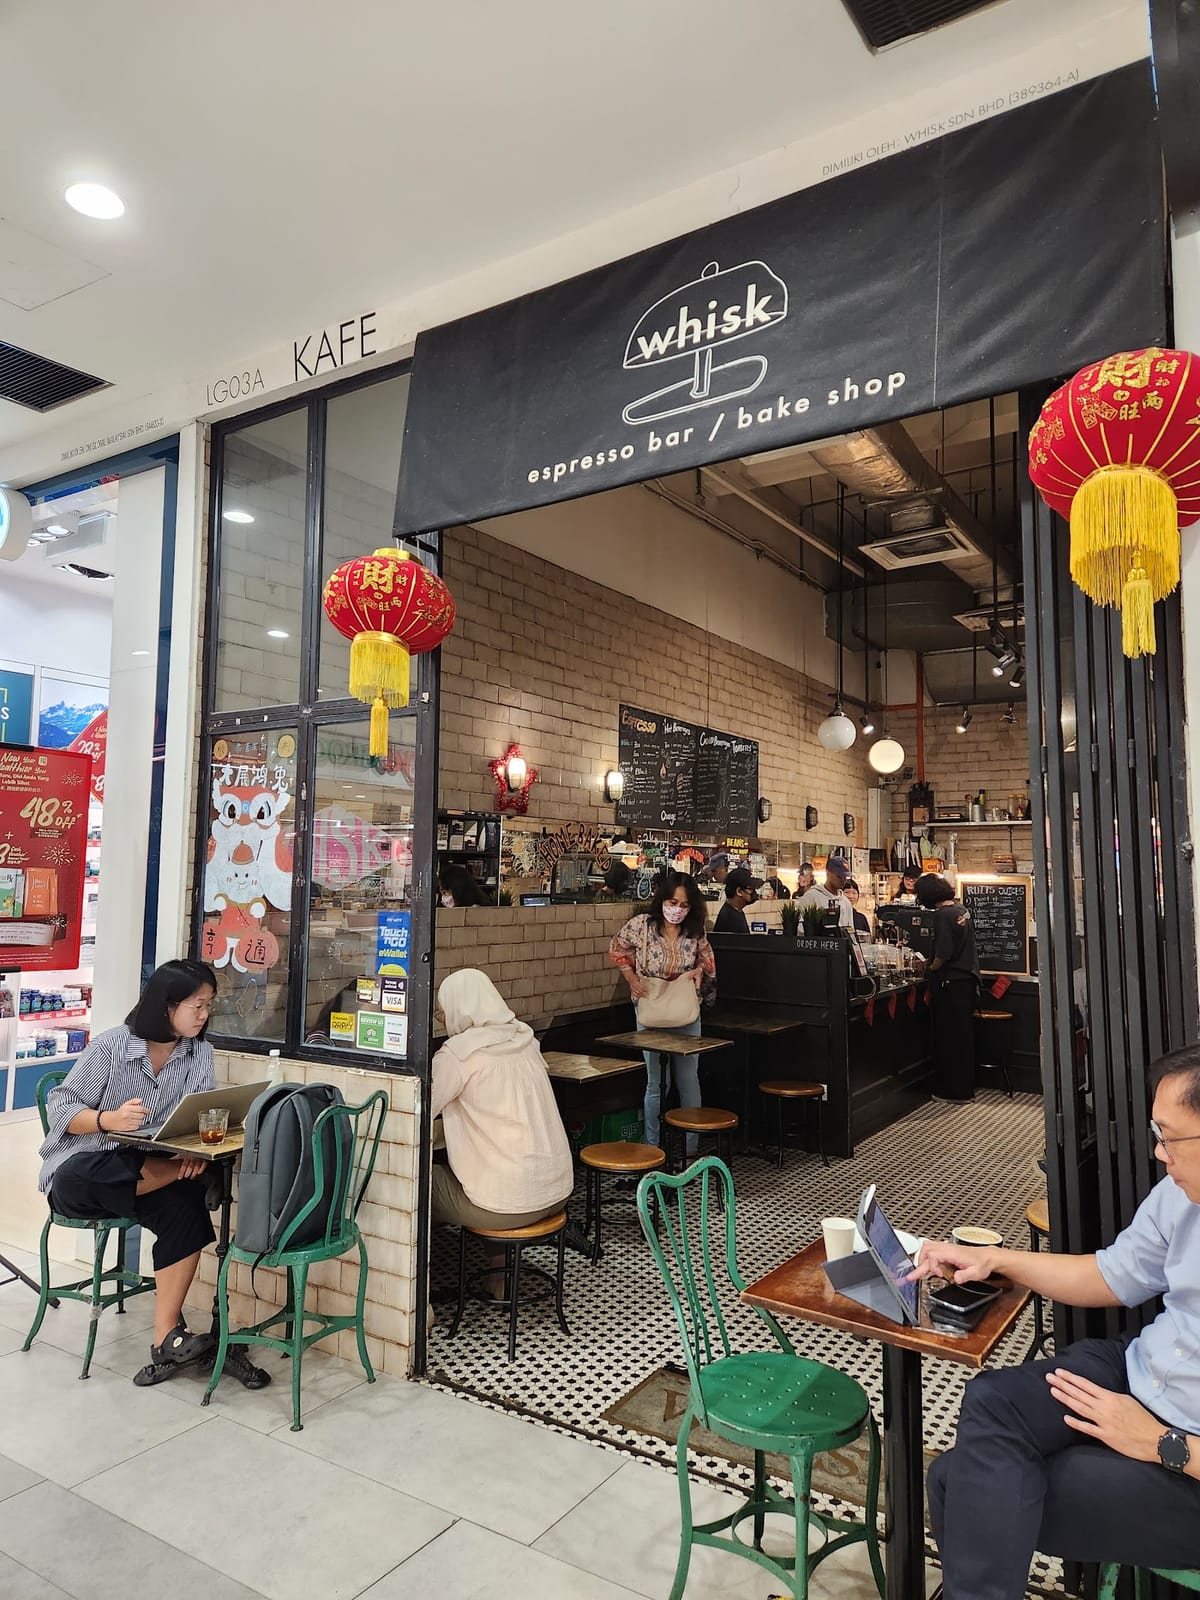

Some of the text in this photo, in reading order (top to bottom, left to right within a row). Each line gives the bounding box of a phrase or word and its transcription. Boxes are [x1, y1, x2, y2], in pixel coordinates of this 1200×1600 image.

[822, 152, 863, 177] DIMILIKI
[903, 121, 946, 145] WHISK
[948, 109, 975, 129] SDN
[978, 98, 1004, 117] BHD
[1008, 68, 1080, 106] (389364-A)
[636, 283, 773, 360] whisk
[206, 311, 377, 406] LG03A KAFE
[527, 443, 635, 484] espresso
[648, 424, 694, 453] bar
[738, 395, 810, 430] bake
[827, 371, 906, 406] shop
[1, 752, 20, 763] New
[379, 926, 408, 938] Touch
[796, 939, 840, 951] ORDER HERE
[386, 996, 402, 1006] VISA
